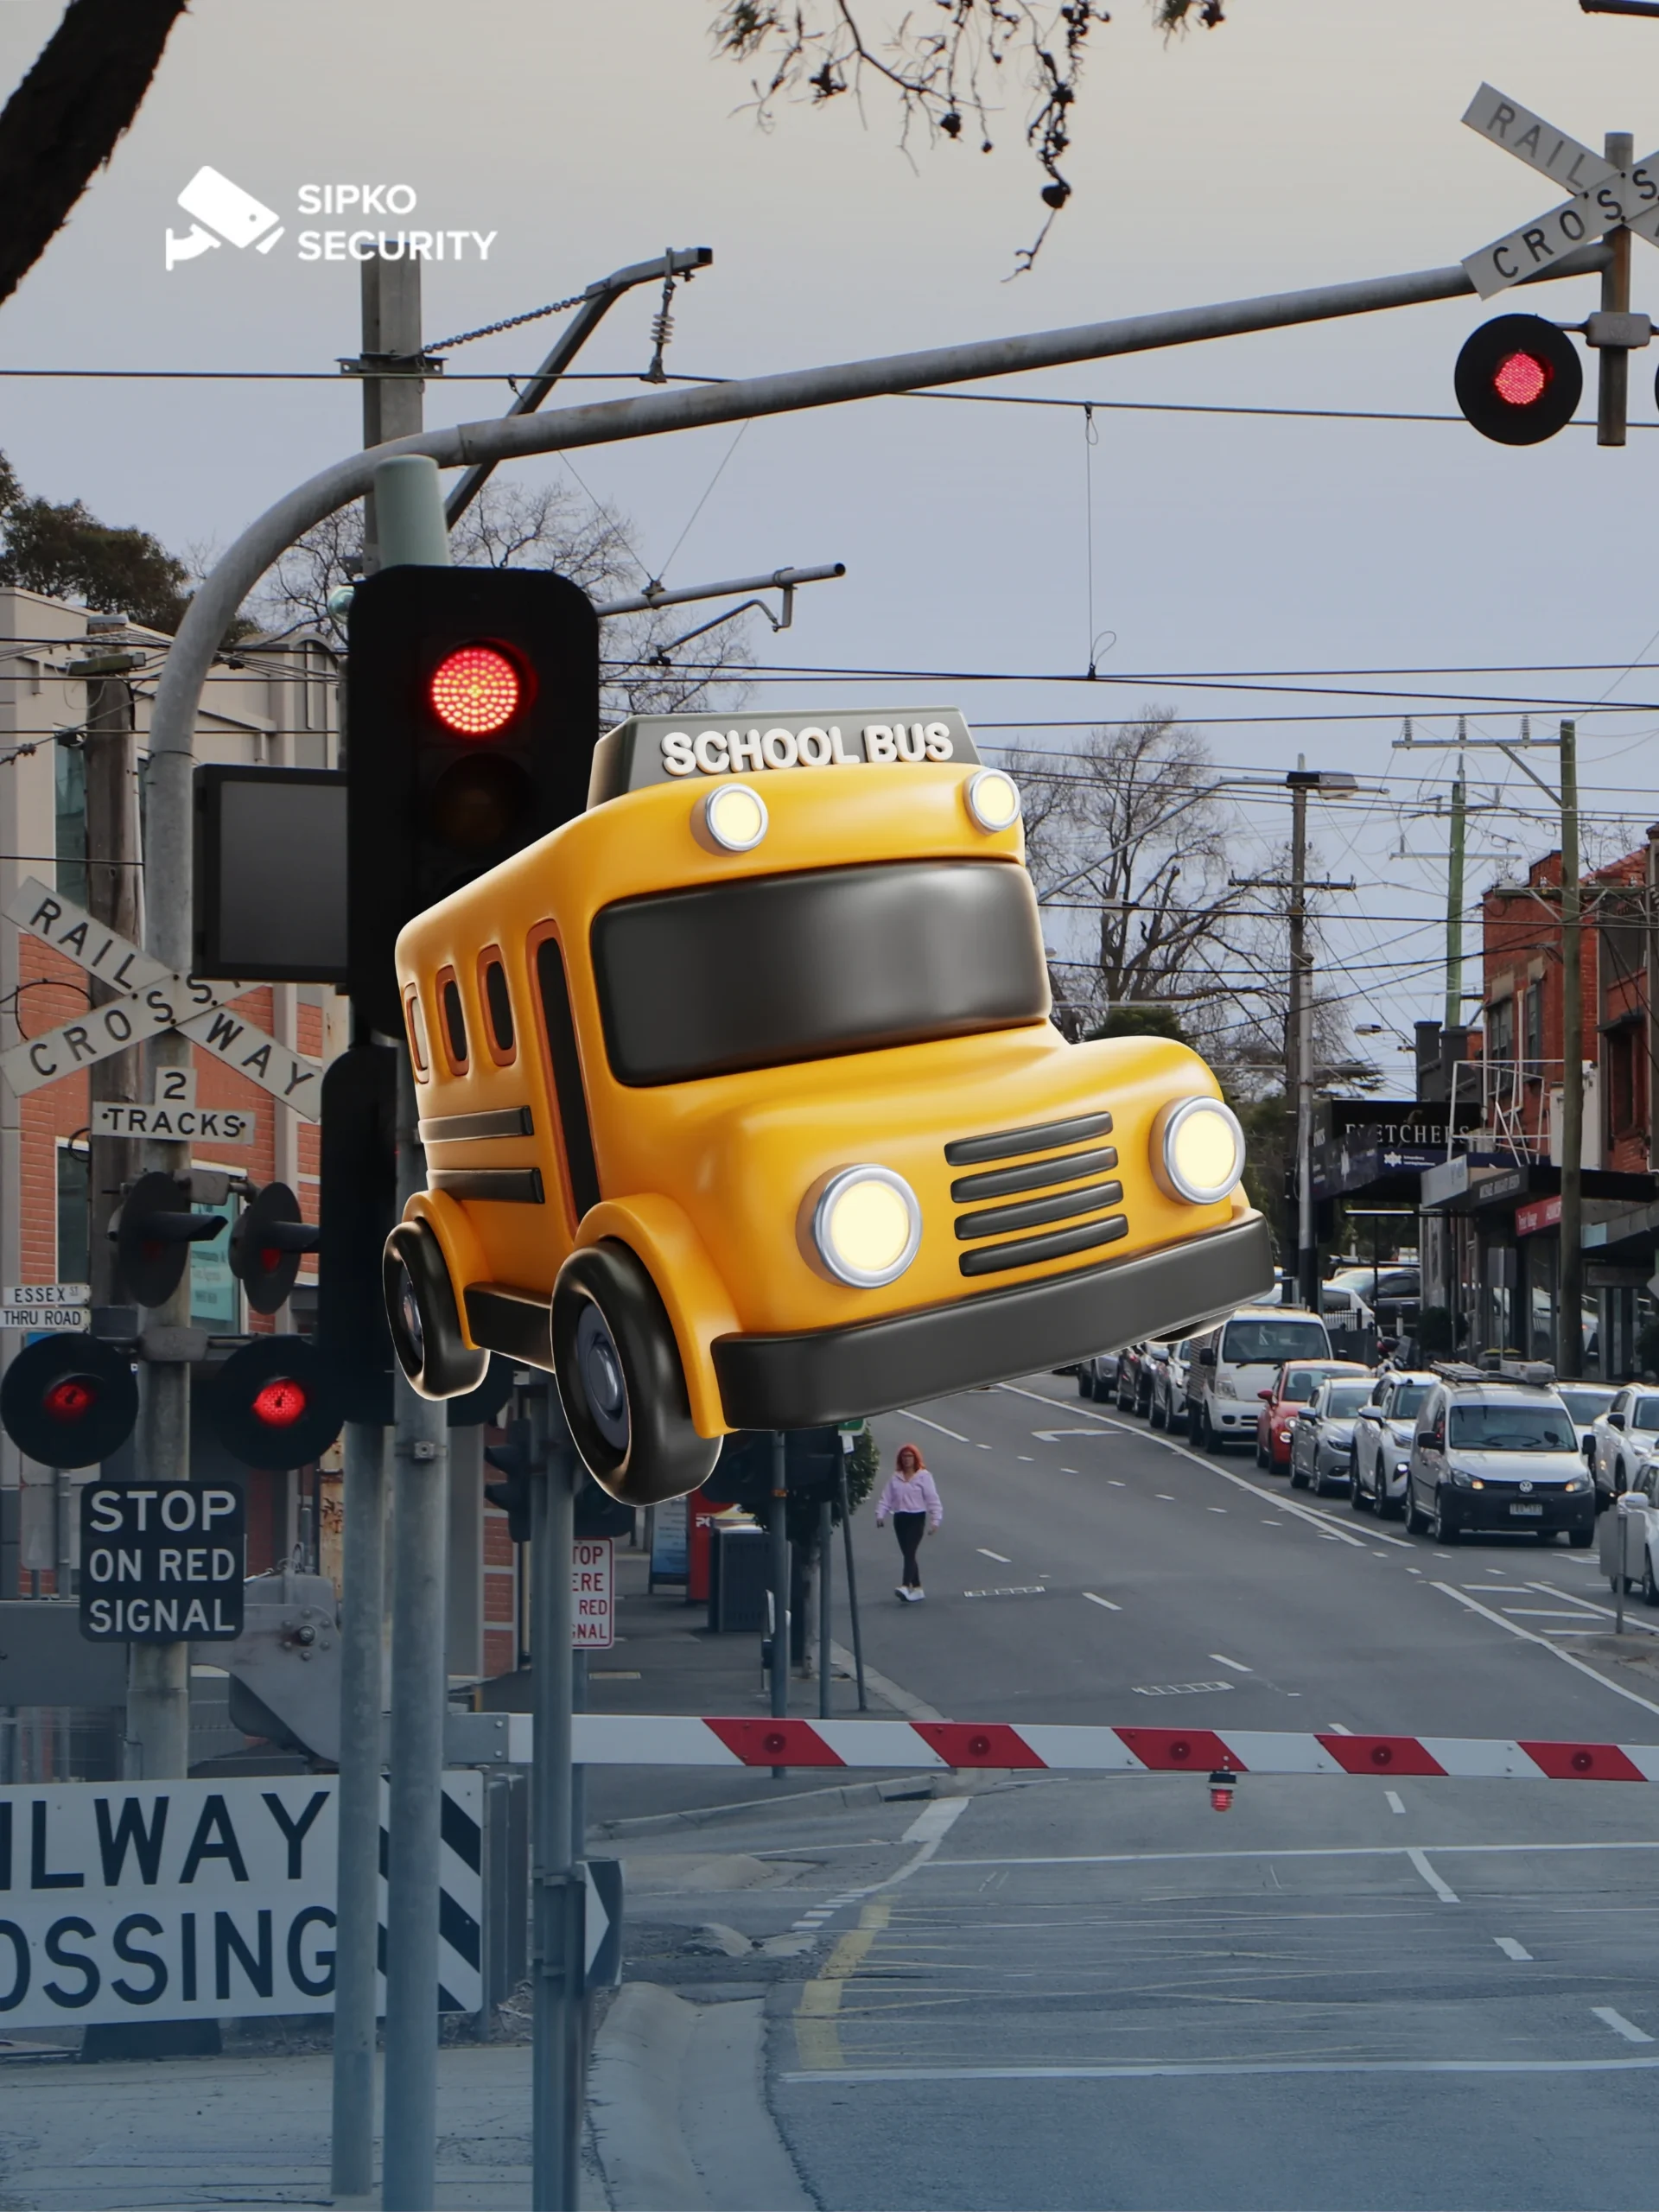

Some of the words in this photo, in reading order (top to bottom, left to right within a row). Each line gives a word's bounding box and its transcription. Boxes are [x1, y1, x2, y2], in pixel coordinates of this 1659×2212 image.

[1486, 102, 1585, 190] RAIL
[661, 726, 861, 776] SCHOOL
[865, 721, 954, 764] BUS
[29, 898, 136, 990] RAIL
[29, 973, 240, 1076] CROSS
[206, 1012, 315, 1096] WAY
[163, 1071, 187, 1100] 2
[107, 1108, 242, 1138] TRACKS
[14, 1287, 66, 1303] ESSEX
[69, 1287, 79, 1296] ST
[3, 1311, 38, 1325] THRU
[44, 1311, 81, 1325] ROAD
[89, 1490, 237, 1532] STOP
[89, 1548, 142, 1582] ON
[158, 1548, 235, 1582] RED
[572, 1545, 604, 1565] TOP
[572, 1573, 604, 1591] ERE
[89, 1599, 236, 1633] SIGNAL
[579, 1599, 607, 1615] RED
[572, 1623, 607, 1639] NAL
